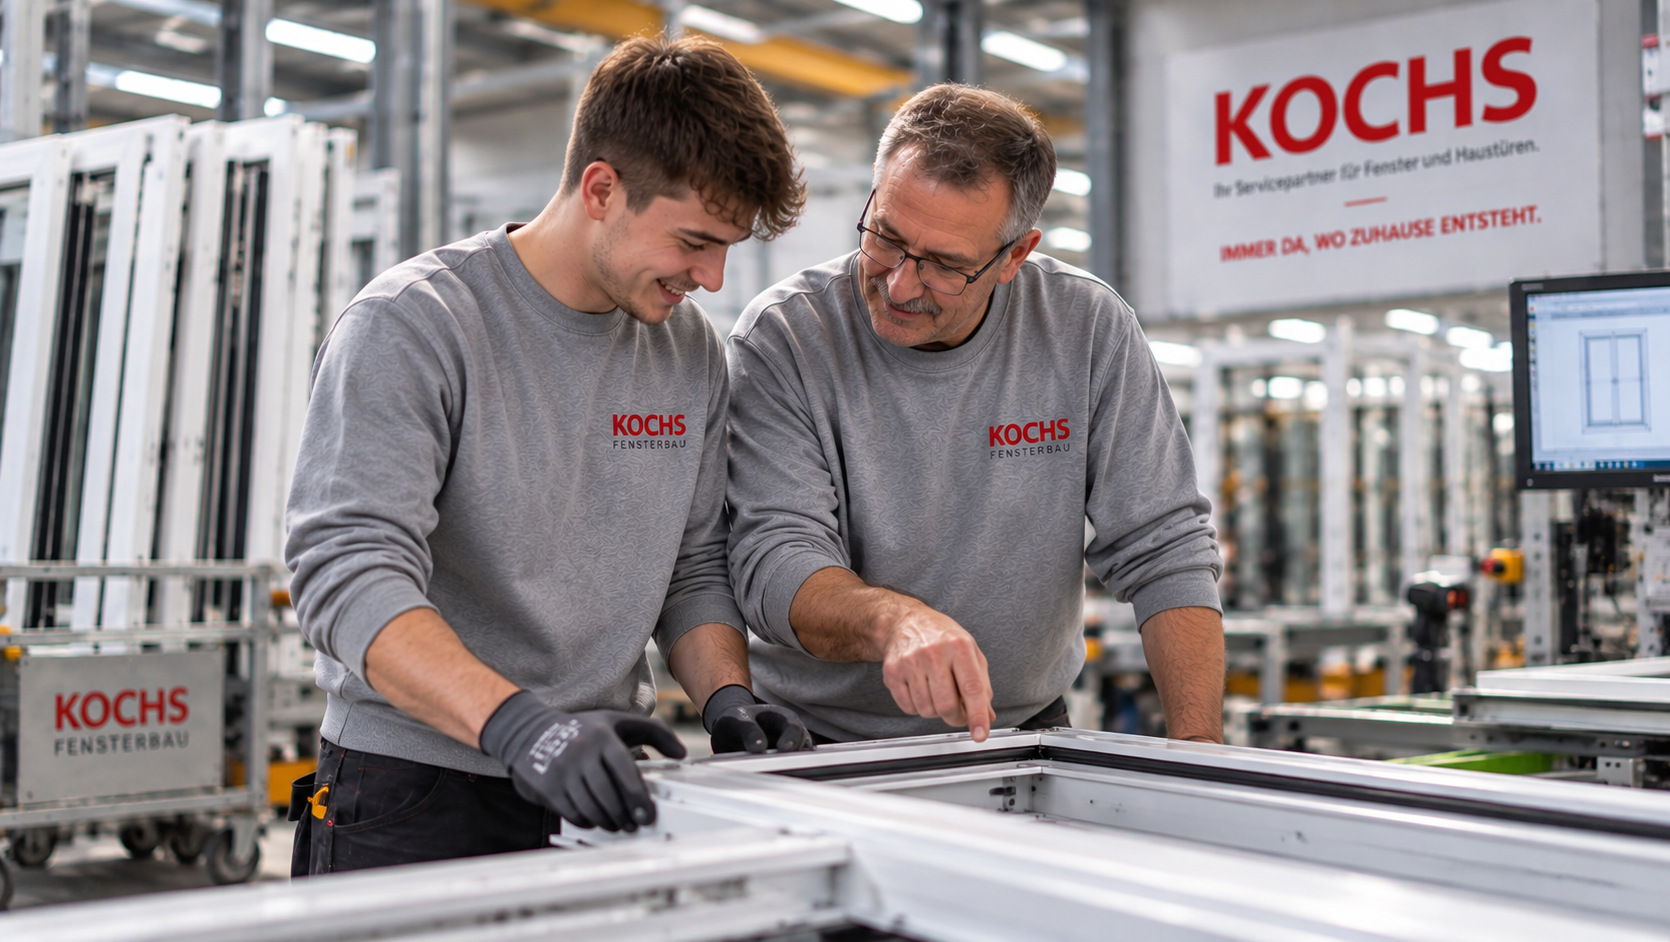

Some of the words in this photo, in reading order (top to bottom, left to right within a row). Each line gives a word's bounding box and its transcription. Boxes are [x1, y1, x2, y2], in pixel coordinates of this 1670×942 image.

[1215, 36, 1538, 166] KOCHS
[1213, 182, 1232, 199] Ihr
[1234, 168, 1337, 197] Servicepartner
[1339, 162, 1361, 181] für
[1364, 155, 1419, 177] Fenster
[1421, 148, 1452, 169] und
[1455, 138, 1540, 164] Haustüren.
[1220, 239, 1277, 262] IMMER
[1281, 234, 1310, 256] DA,
[1313, 230, 1346, 250] WO
[1349, 217, 1435, 247] ZUHAUSE
[1440, 204, 1542, 235] ENTSTEHT.
[612, 414, 687, 436] KOCHS
[989, 418, 1070, 447] KOCHS
[612, 440, 687, 450] FENSTERBAU
[990, 443, 1070, 460] FENSTERBAU
[54, 686, 190, 731] KOCHS
[54, 730, 190, 757] FENSTERBAU
